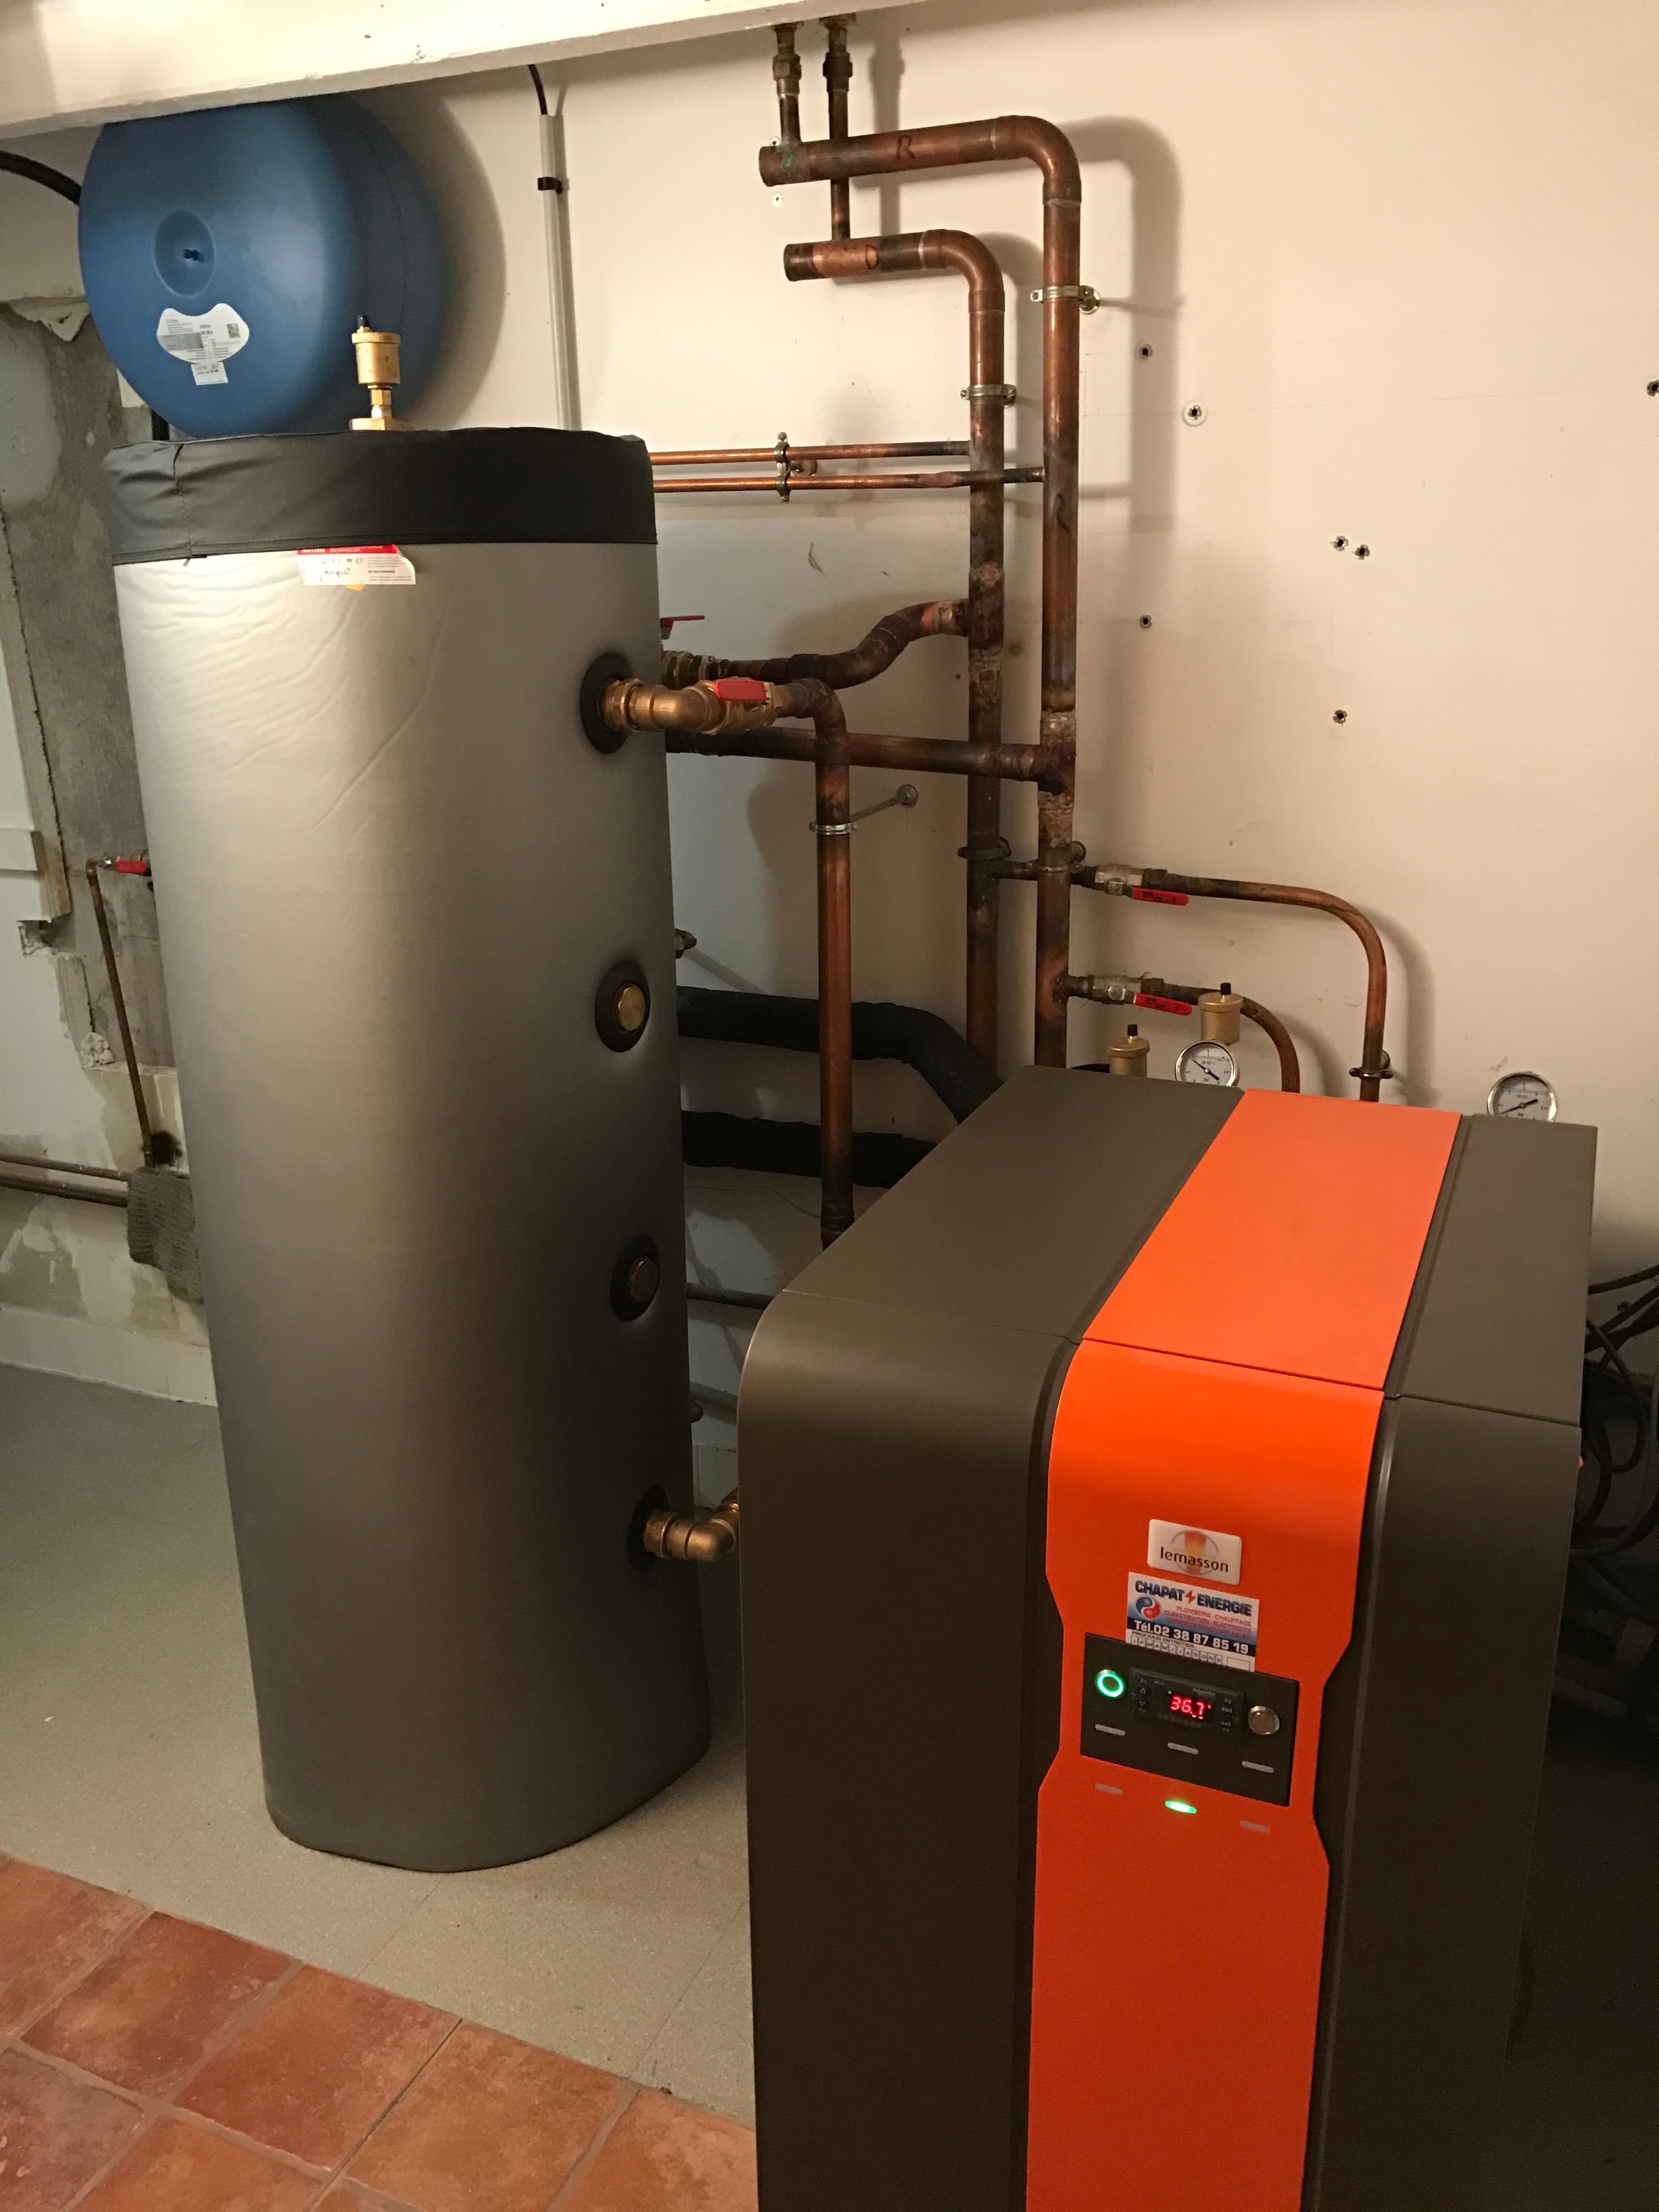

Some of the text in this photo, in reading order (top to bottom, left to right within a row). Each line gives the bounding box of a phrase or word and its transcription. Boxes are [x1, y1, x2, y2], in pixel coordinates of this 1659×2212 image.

[896, 135, 916, 160] R
[1160, 1546, 1228, 1572] lemasson
[1135, 1580, 1252, 1617] CHAPAT ENERGIE
[1215, 1614, 1251, 1627] CHAUFFAGE
[1132, 1630, 1162, 1641] PROCHAIN
[1173, 1629, 1189, 1641] 38
[1193, 1633, 1209, 1645] 87
[1212, 1638, 1229, 1650] 85
[1233, 1642, 1249, 1654] 19
